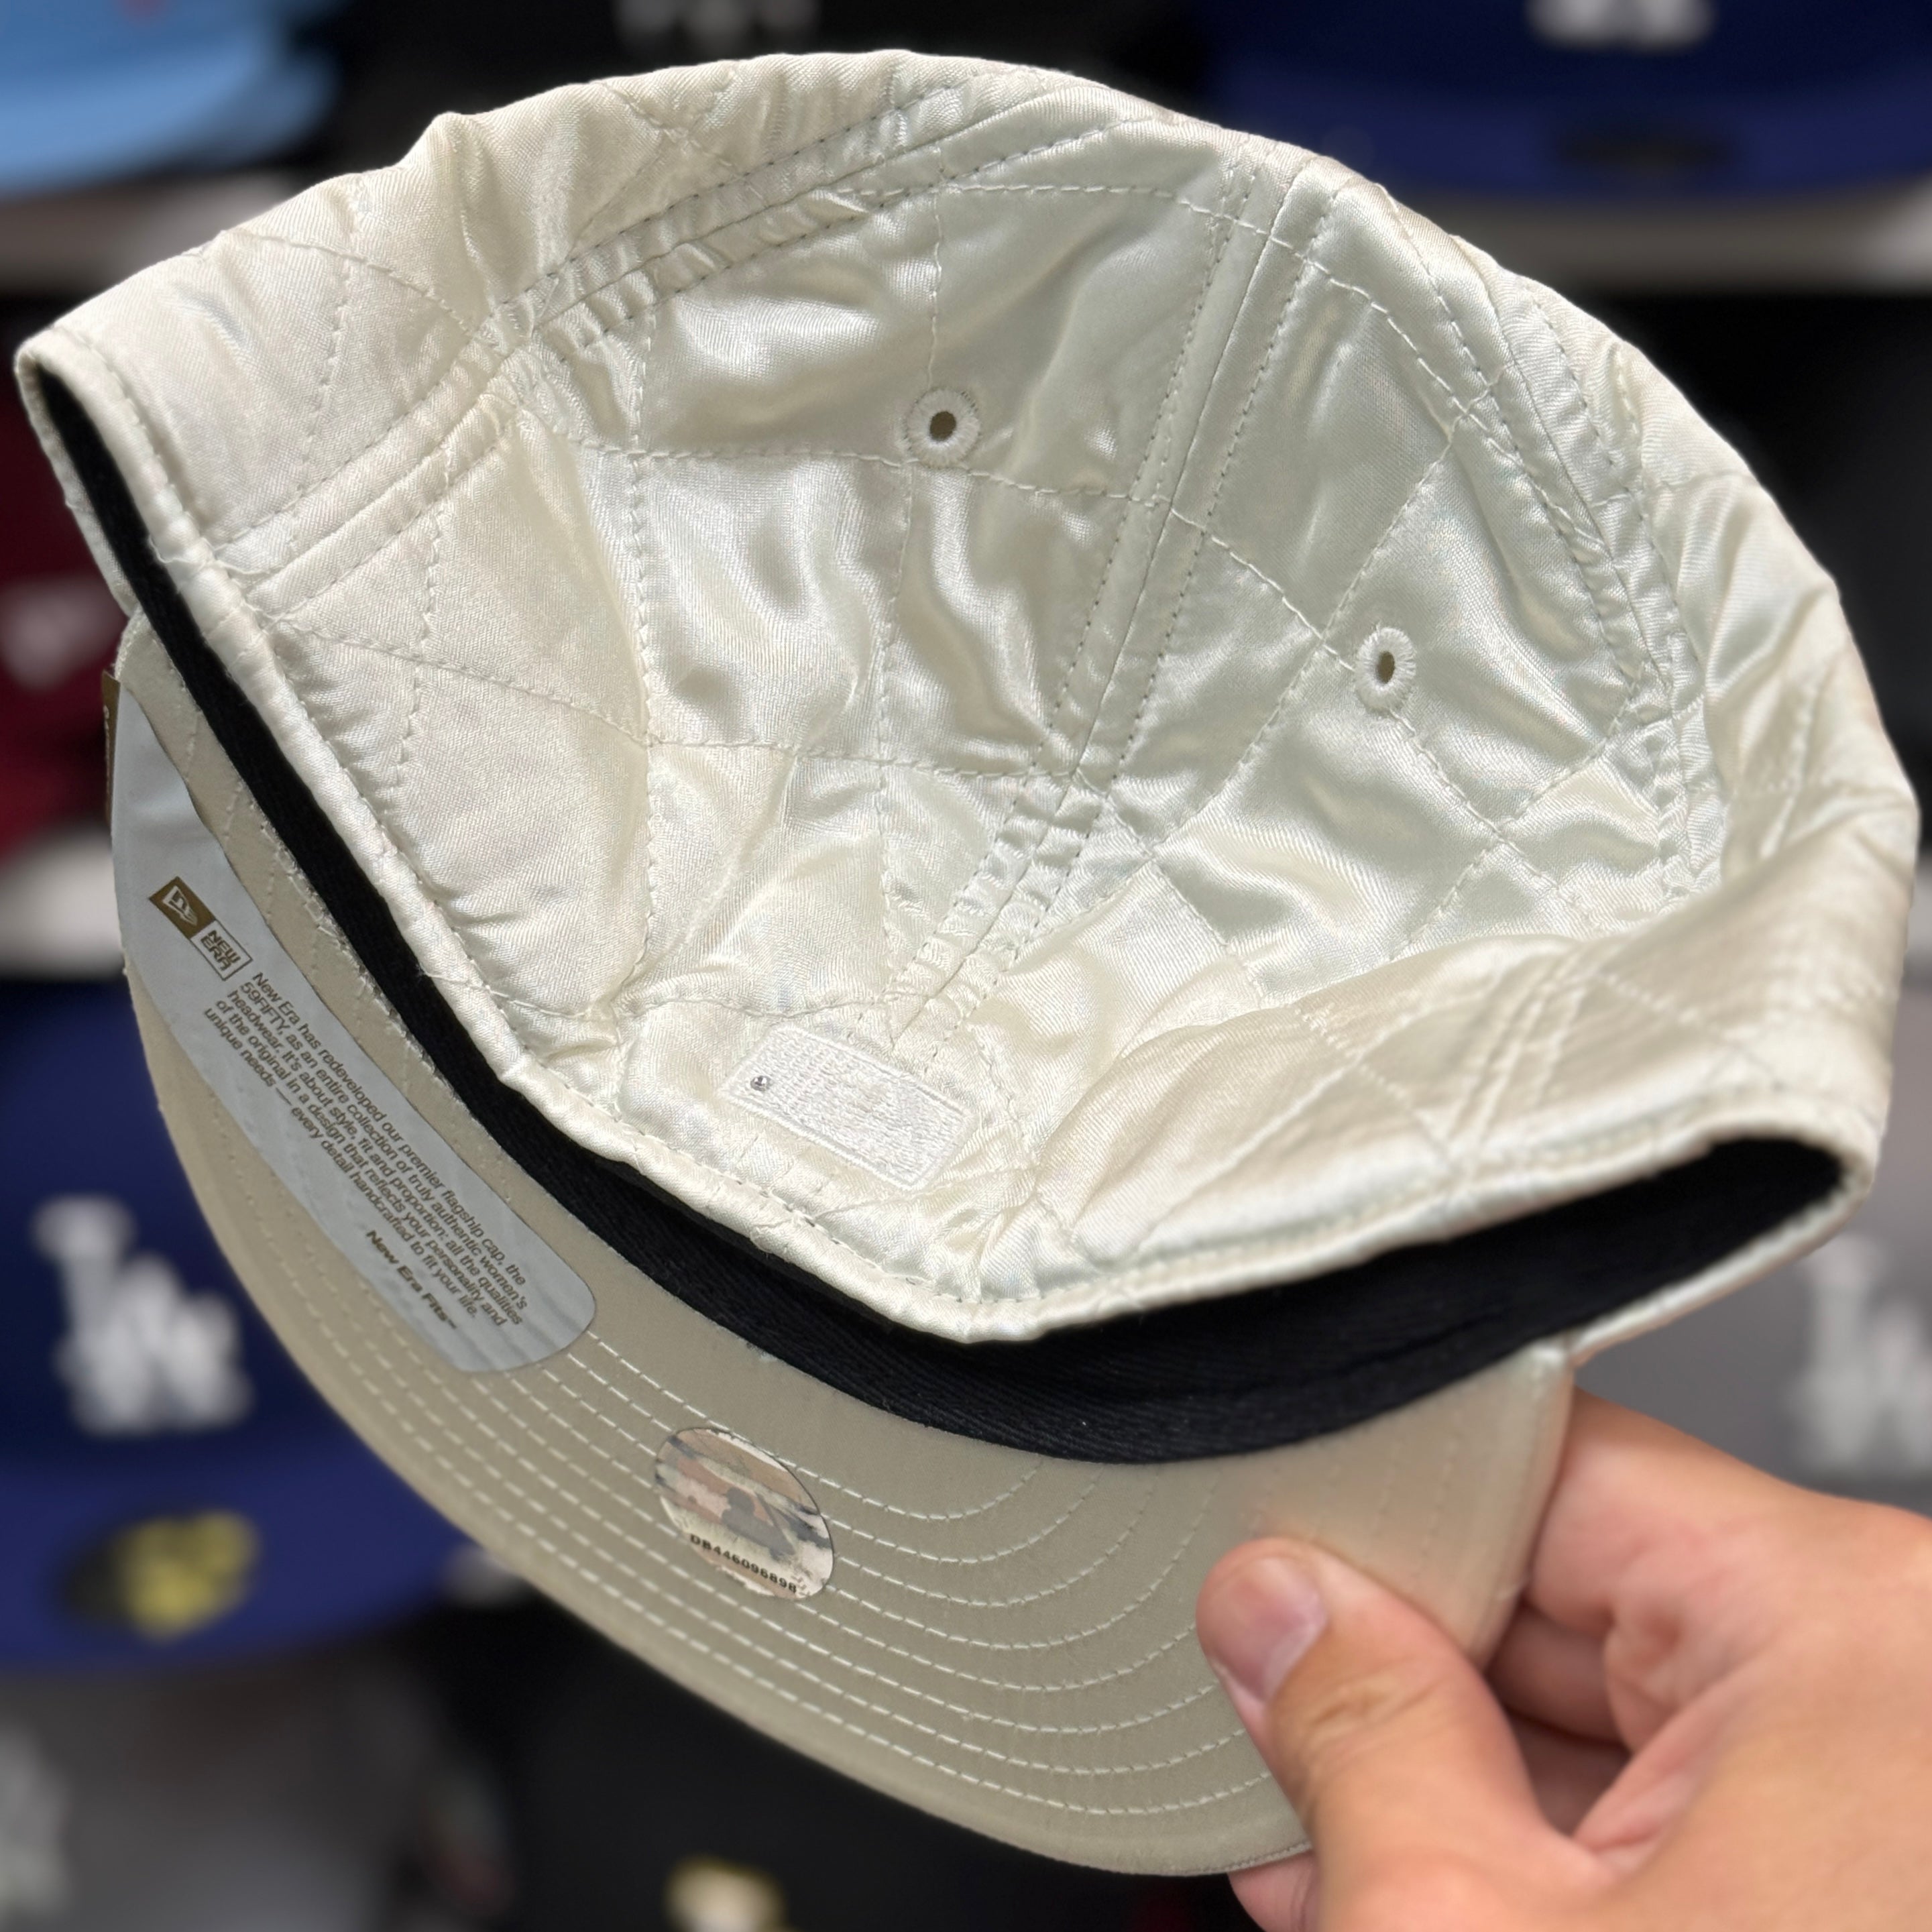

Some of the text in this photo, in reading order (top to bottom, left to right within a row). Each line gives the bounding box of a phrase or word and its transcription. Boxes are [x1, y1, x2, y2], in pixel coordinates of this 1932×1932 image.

[201, 935, 231, 971] ERA
[208, 930, 241, 963] NEW
[203, 1007, 243, 1050] unique
[239, 1049, 276, 1087] needs
[290, 1106, 324, 1139] every
[319, 1136, 355, 1174] detail
[348, 1170, 416, 1242] handcrafted
[409, 1240, 424, 1256] to
[421, 1254, 439, 1269] fit
[431, 1267, 461, 1294] your
[457, 1294, 477, 1318] life.
[214, 999, 508, 1326] of the original in a design that reflects your personality and
[227, 989, 284, 1054] headwear.
[280, 1049, 302, 1072] It's
[298, 1071, 334, 1108] about
[328, 1106, 357, 1140] style,
[357, 1137, 374, 1154] fit
[368, 1152, 397, 1178] and
[444, 1239, 465, 1256] all
[459, 1254, 481, 1277] the
[477, 1276, 523, 1325] qualities
[251, 971, 526, 1286] New Era has redeveloped our premier flagship cap, the
[284, 1033, 304, 1051] as
[299, 1050, 319, 1069] an
[315, 1068, 349, 1104] entire
[345, 1103, 398, 1161] collection
[394, 1159, 414, 1174] of
[407, 1173, 435, 1202] truly
[430, 1202, 482, 1256] authentic
[479, 1255, 527, 1310] women's
[365, 1229, 400, 1265] New
[396, 1265, 423, 1294] Era
